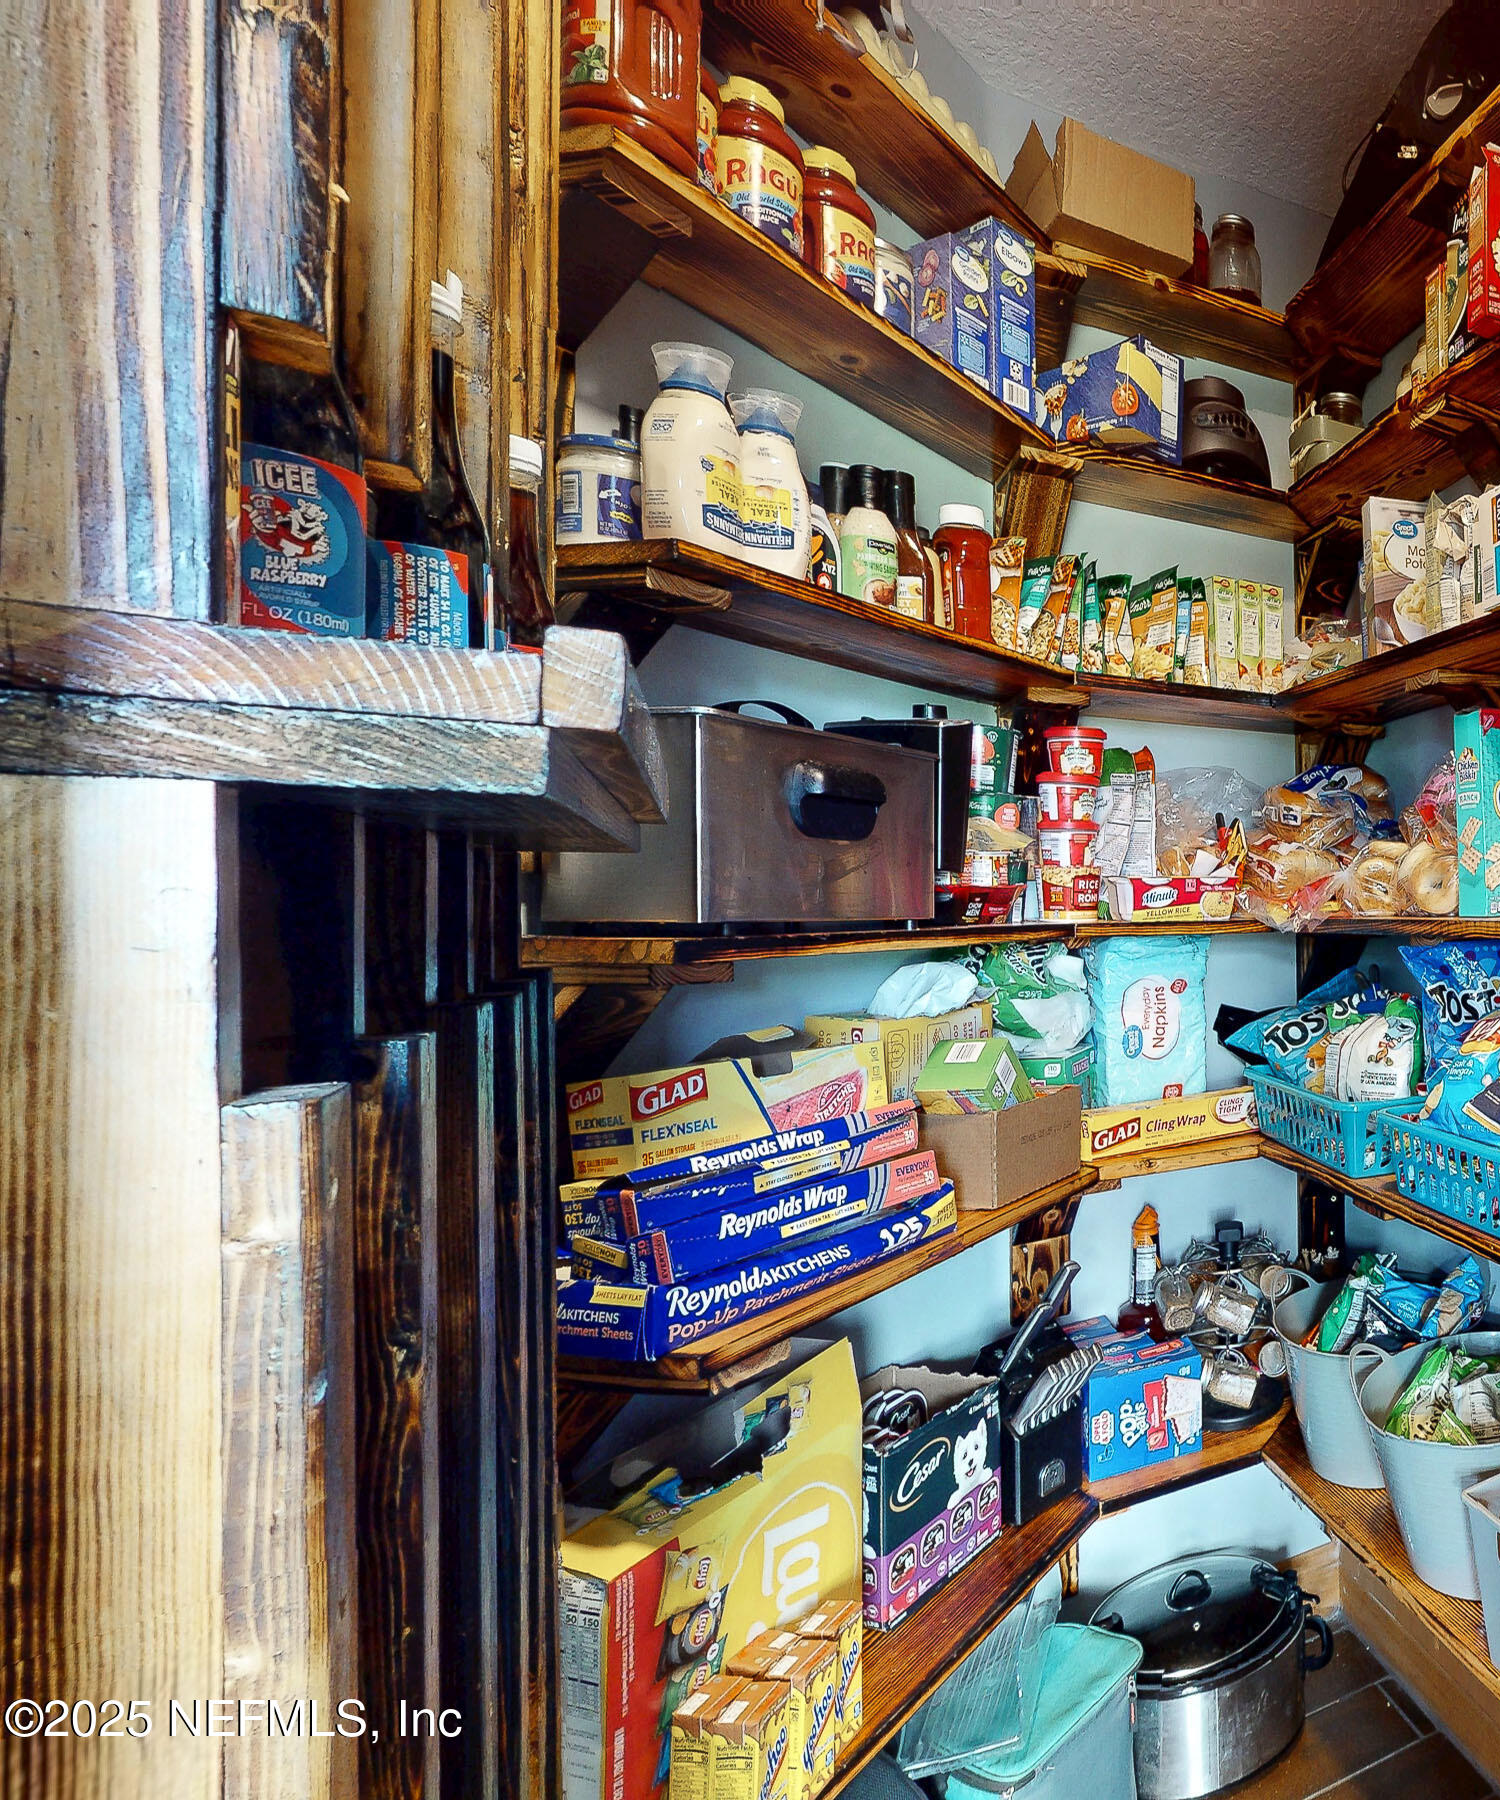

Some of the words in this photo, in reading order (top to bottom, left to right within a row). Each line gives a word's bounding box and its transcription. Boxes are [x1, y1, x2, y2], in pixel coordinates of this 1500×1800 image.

[1001, 245, 1029, 271] Elbows
[251, 459, 318, 499] ICEE
[750, 507, 779, 520] REAL
[1394, 522, 1415, 533] Great
[264, 554, 300, 571] BLUE
[249, 566, 328, 589] RASPBERRY
[241, 601, 265, 617] FL
[268, 605, 294, 623] OZ
[1458, 794, 1478, 803] RANCH
[1078, 879, 1098, 890] RICE
[1143, 889, 1178, 904] Minute
[1146, 907, 1174, 917] YELLOW
[1175, 906, 1191, 915] RICE
[1141, 985, 1152, 1031] Everyday
[1152, 985, 1169, 1049] Napkins
[568, 1086, 602, 1111] GLAD
[636, 1074, 704, 1116] GLAD
[1218, 1096, 1245, 1108] CLINGS
[1217, 1104, 1243, 1116] TIGHT
[1093, 1120, 1140, 1151] GLAD
[641, 1151, 654, 1167] 35
[674, 1143, 697, 1155] STORAGE
[690, 1136, 777, 1174] Reynolds
[777, 1129, 826, 1154] Wrap
[895, 1159, 930, 1177] EVERYDAY
[923, 1169, 935, 1181] 30
[718, 1194, 801, 1241] Reynolds
[801, 1184, 848, 1213] Wrap
[665, 1266, 773, 1318] Reynolds
[772, 1244, 851, 1278] KITCHENS
[879, 1215, 924, 1252] 125
[594, 1291, 617, 1300] SHEETS
[566, 1309, 620, 1325] KITCHENS
[668, 1305, 739, 1344] Pop-Up
[743, 1272, 830, 1313] Parchment
[601, 1326, 634, 1341] Sheets
[896, 1443, 947, 1505] Cesar
[582, 1616, 600, 1629] 150
[744, 1760, 753, 1769] 90
